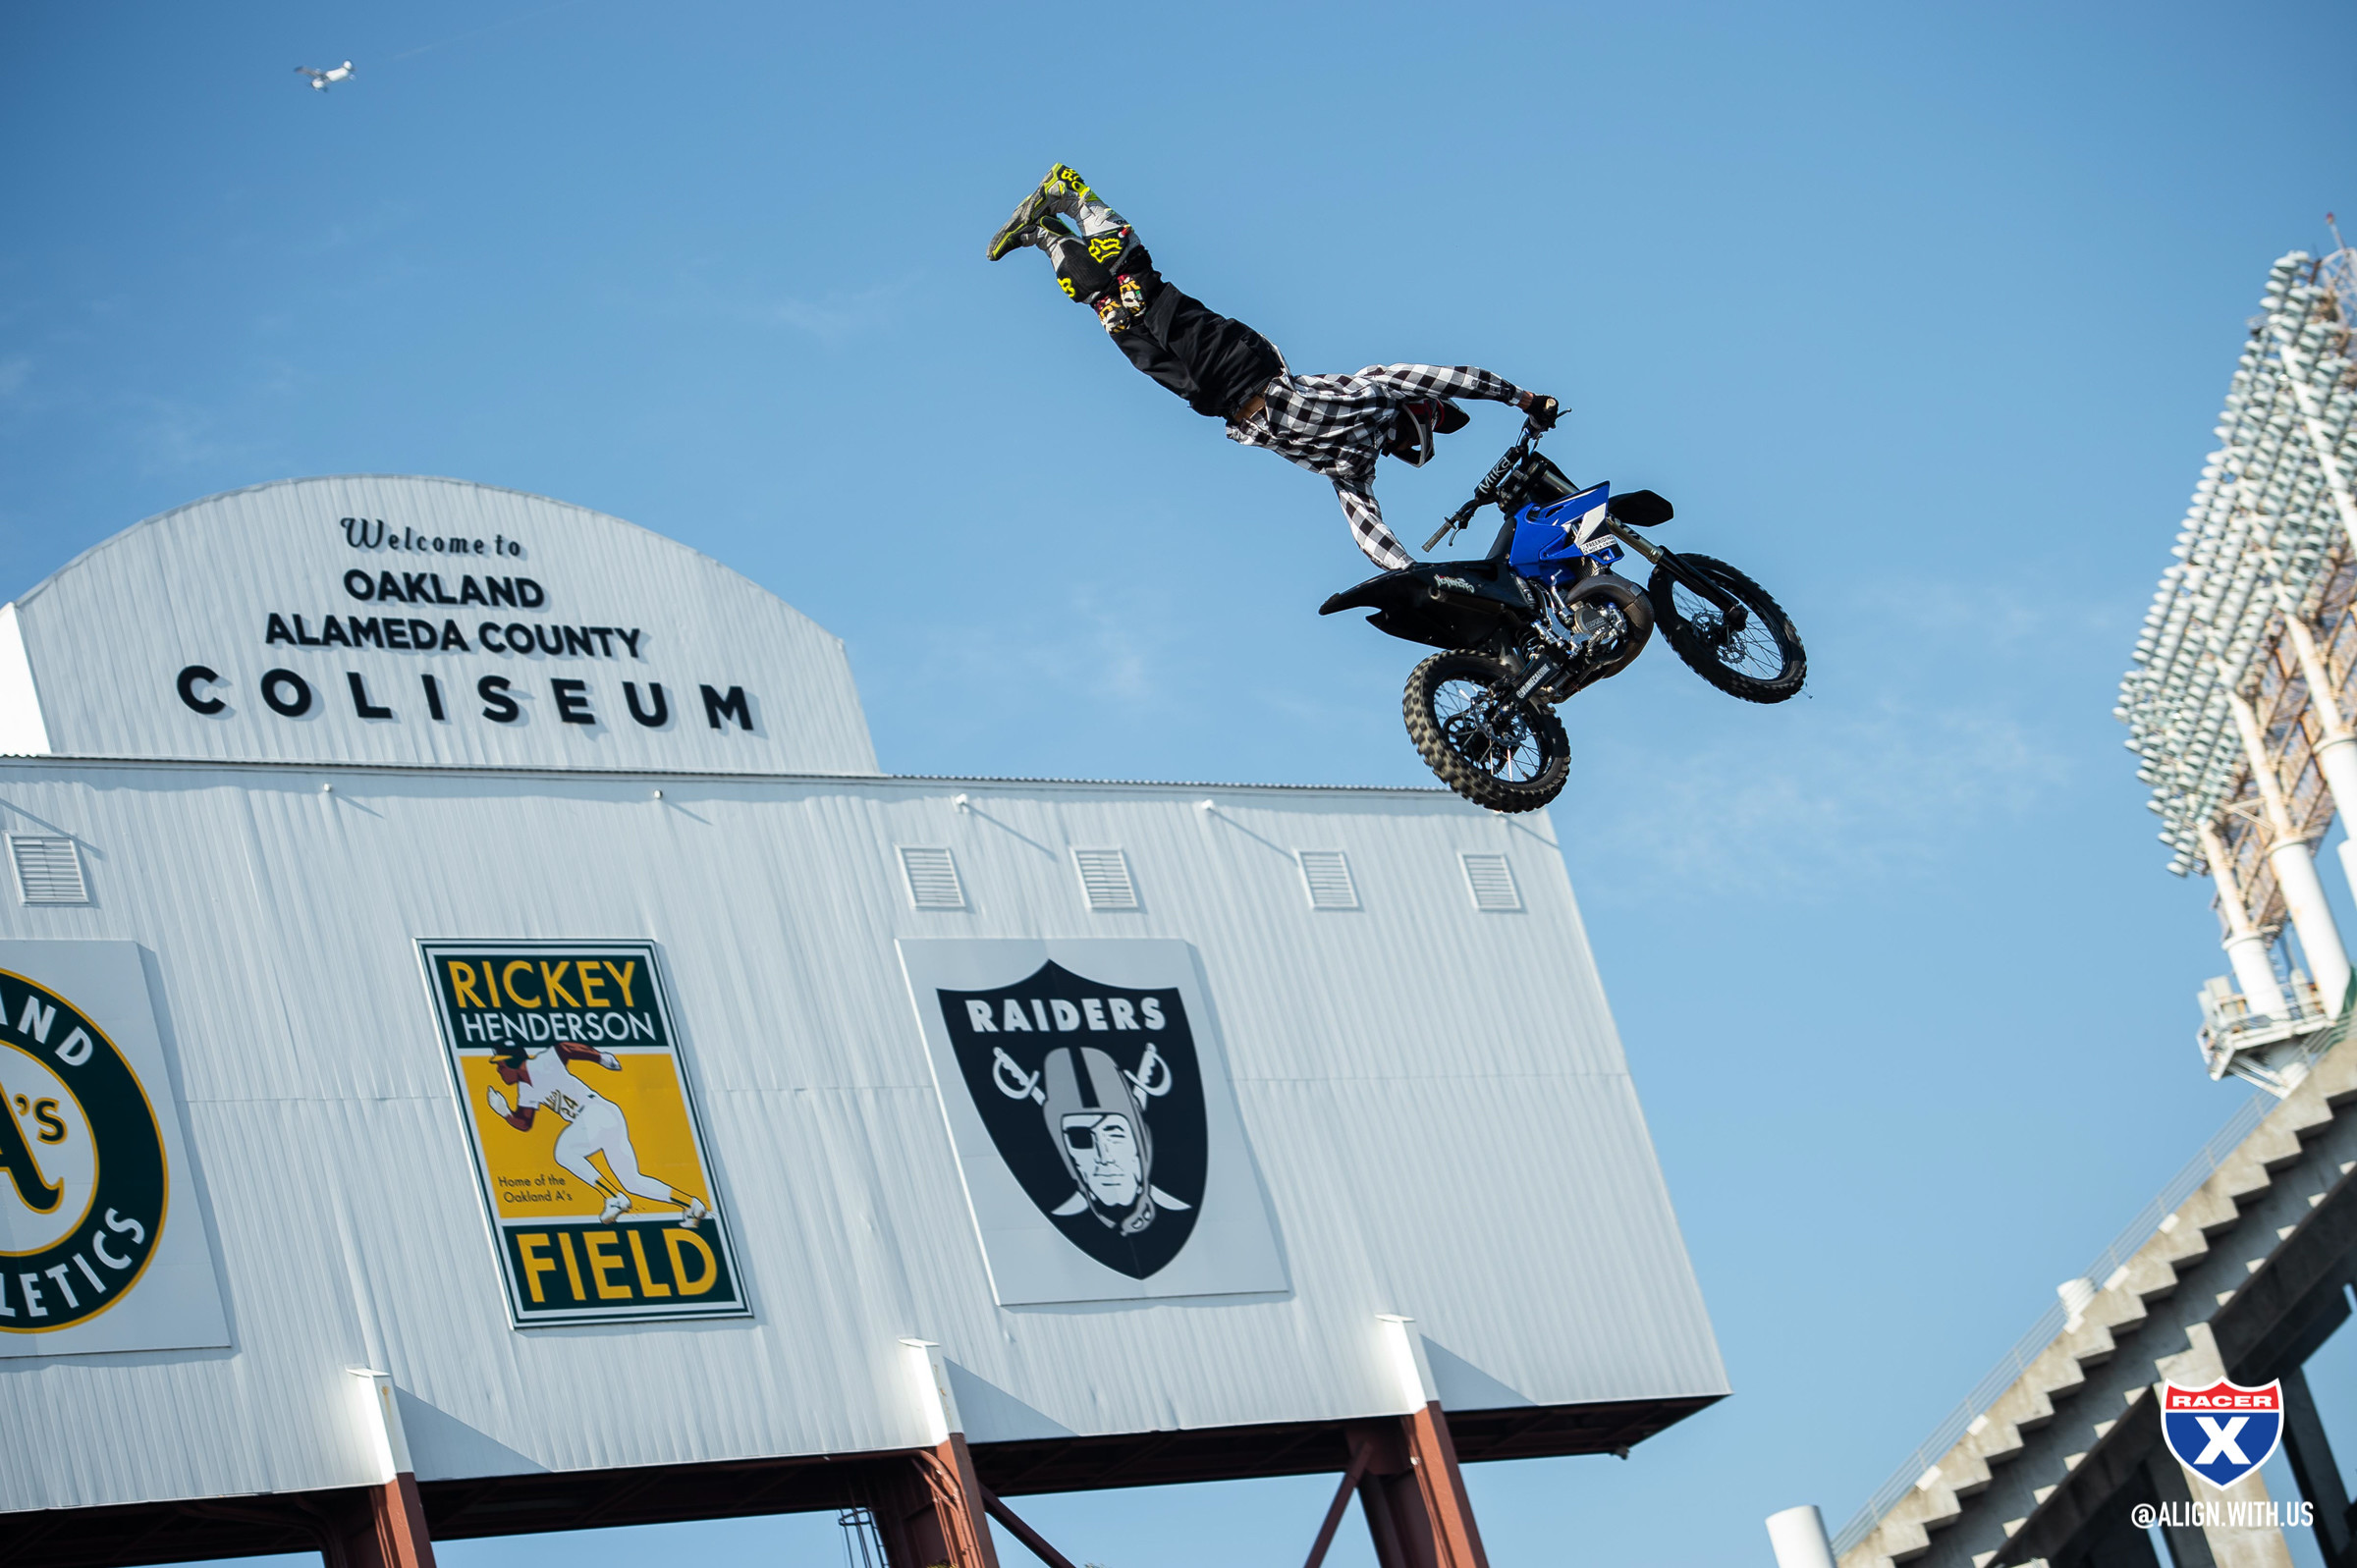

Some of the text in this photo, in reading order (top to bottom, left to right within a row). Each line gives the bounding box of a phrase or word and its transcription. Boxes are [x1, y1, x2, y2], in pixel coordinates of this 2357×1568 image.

[340, 517, 521, 557] Welcome to
[343, 568, 545, 609] OAKLAND
[265, 613, 640, 659] ALAMEDA COUNTY
[176, 664, 754, 731] COLISEUM
[447, 960, 636, 1008] RICKEY
[460, 1011, 657, 1043] HENDERSON
[964, 997, 1167, 1033] RAIDERS
[497, 1173, 567, 1188] Home of the
[503, 1189, 574, 1204] Oakland A's
[516, 1227, 718, 1304] FIELD
